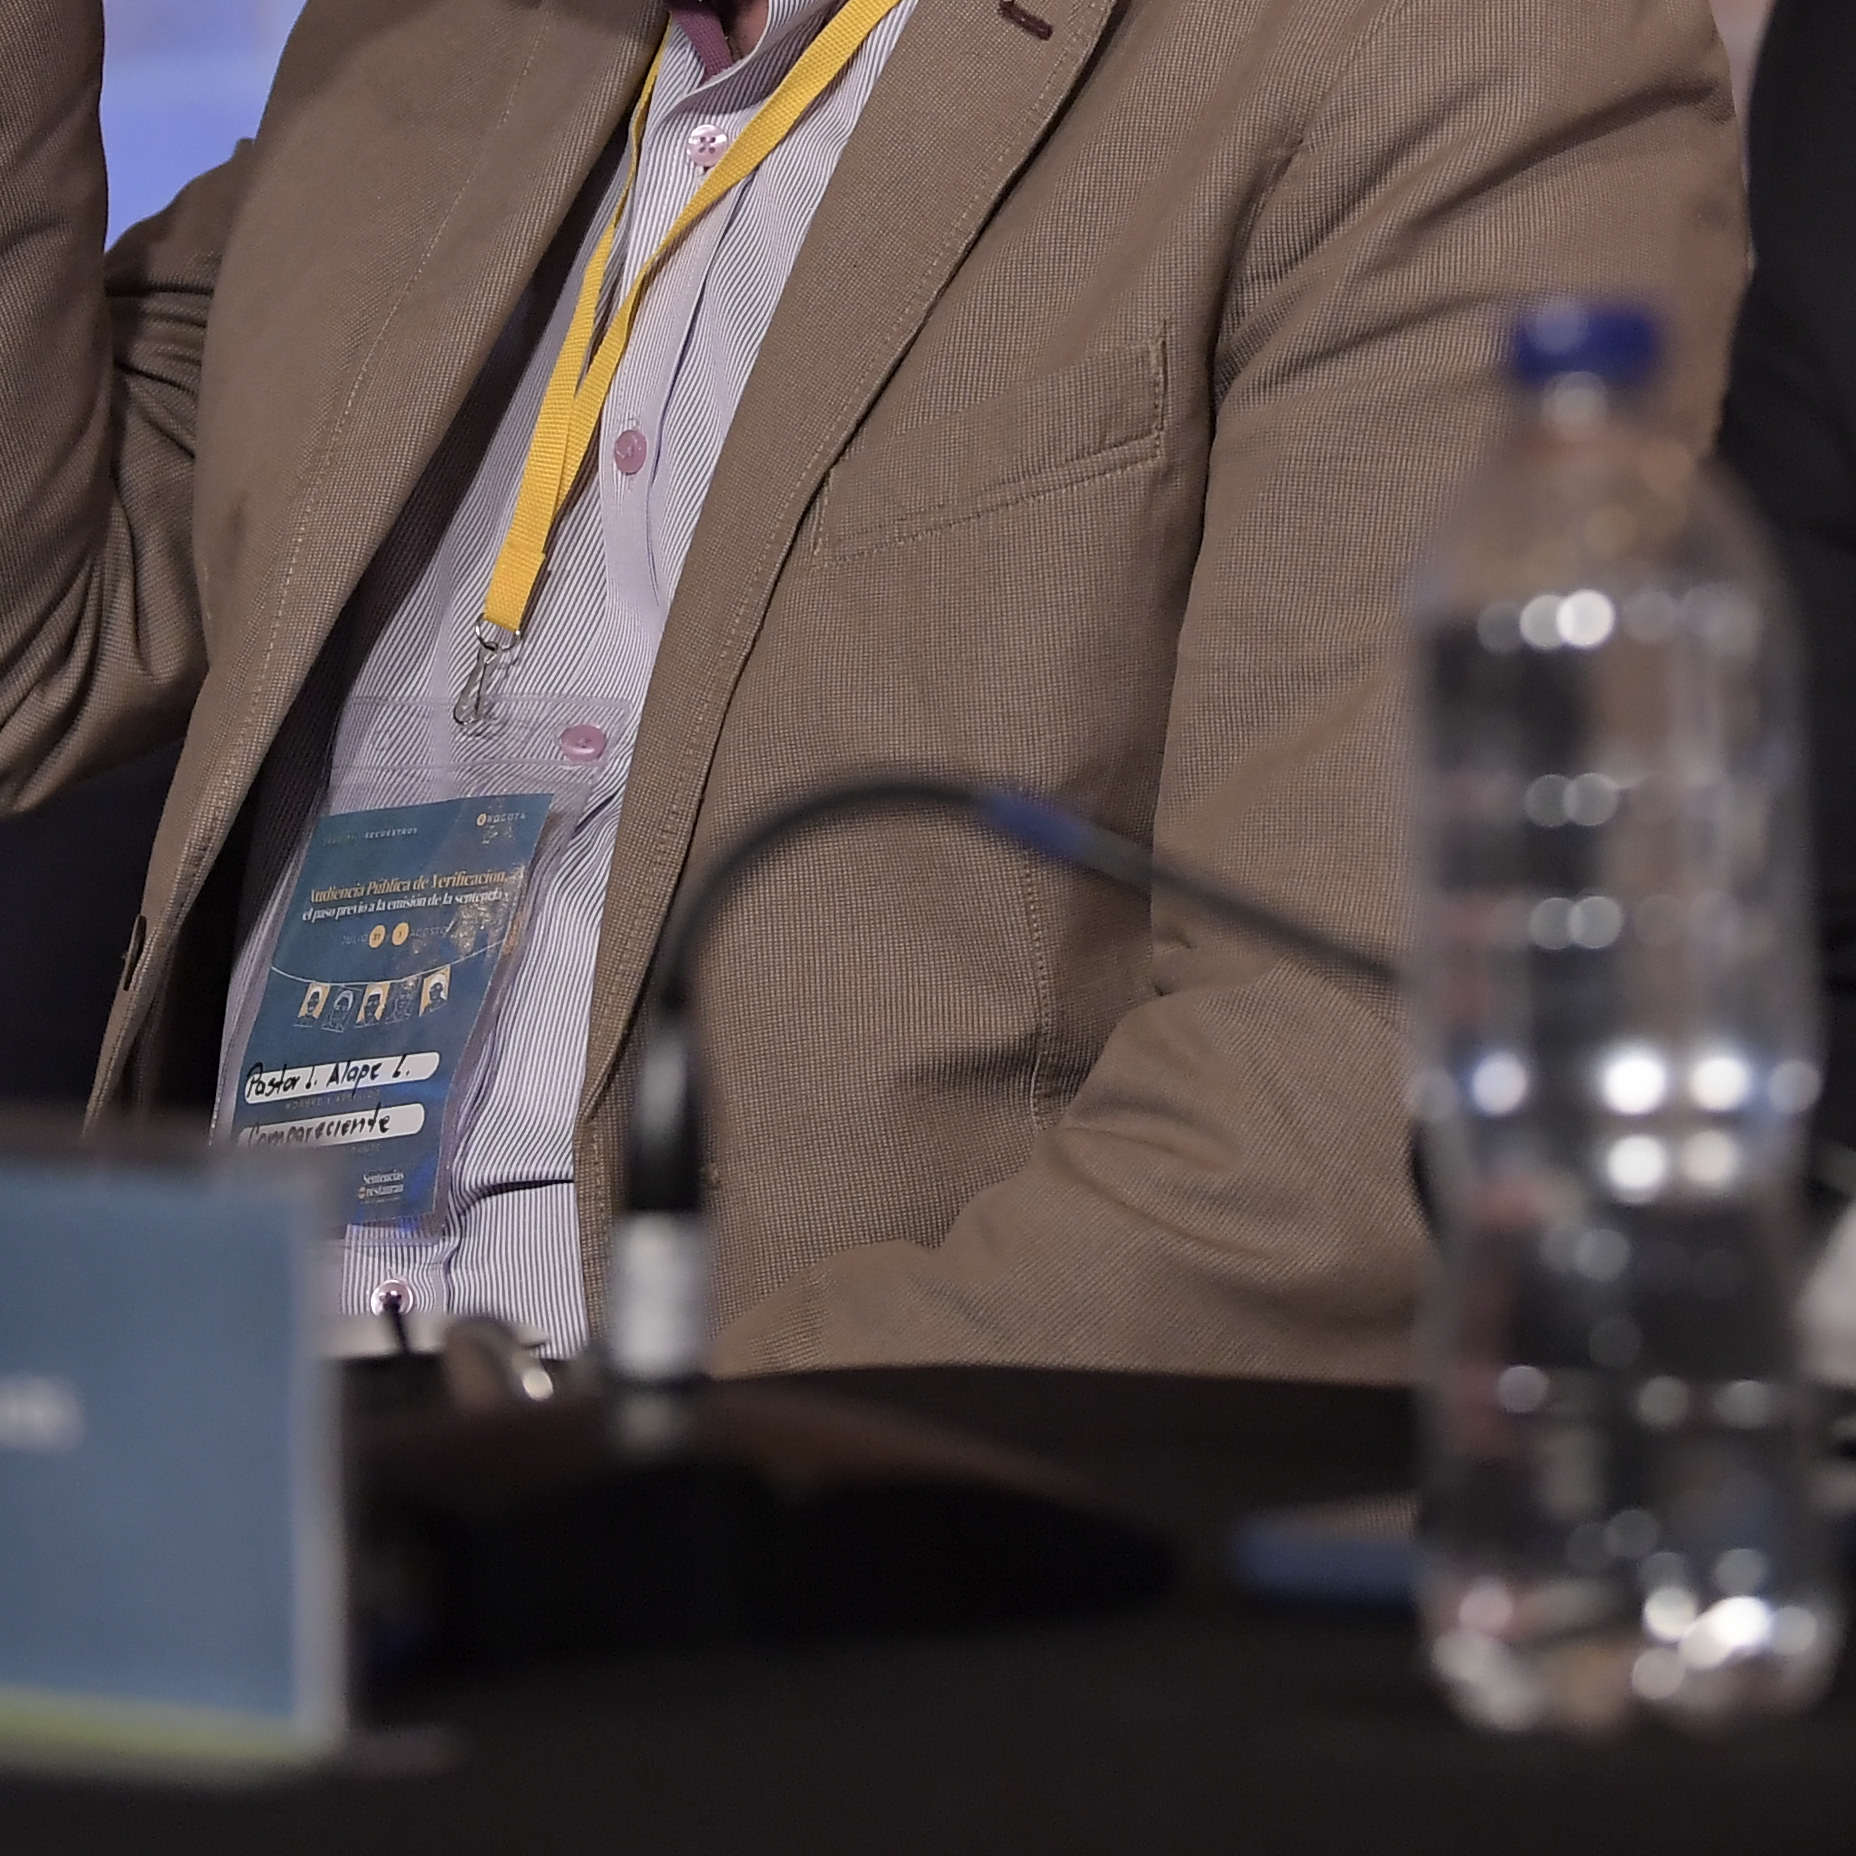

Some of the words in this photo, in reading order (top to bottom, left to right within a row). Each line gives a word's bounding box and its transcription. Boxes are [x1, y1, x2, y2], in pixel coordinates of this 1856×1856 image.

[310, 882, 365, 903] Audiencia
[366, 877, 411, 896] Pública
[413, 875, 428, 890] de
[302, 907, 314, 921] el
[311, 907, 335, 923] paso
[335, 901, 367, 920] previo
[368, 903, 375, 913] a
[376, 898, 386, 912] la
[387, 894, 426, 910] emisión
[427, 893, 442, 906] de
[442, 892, 452, 905] la
[247, 1062, 301, 1098] Pastor
[326, 1060, 383, 1098] Alape
